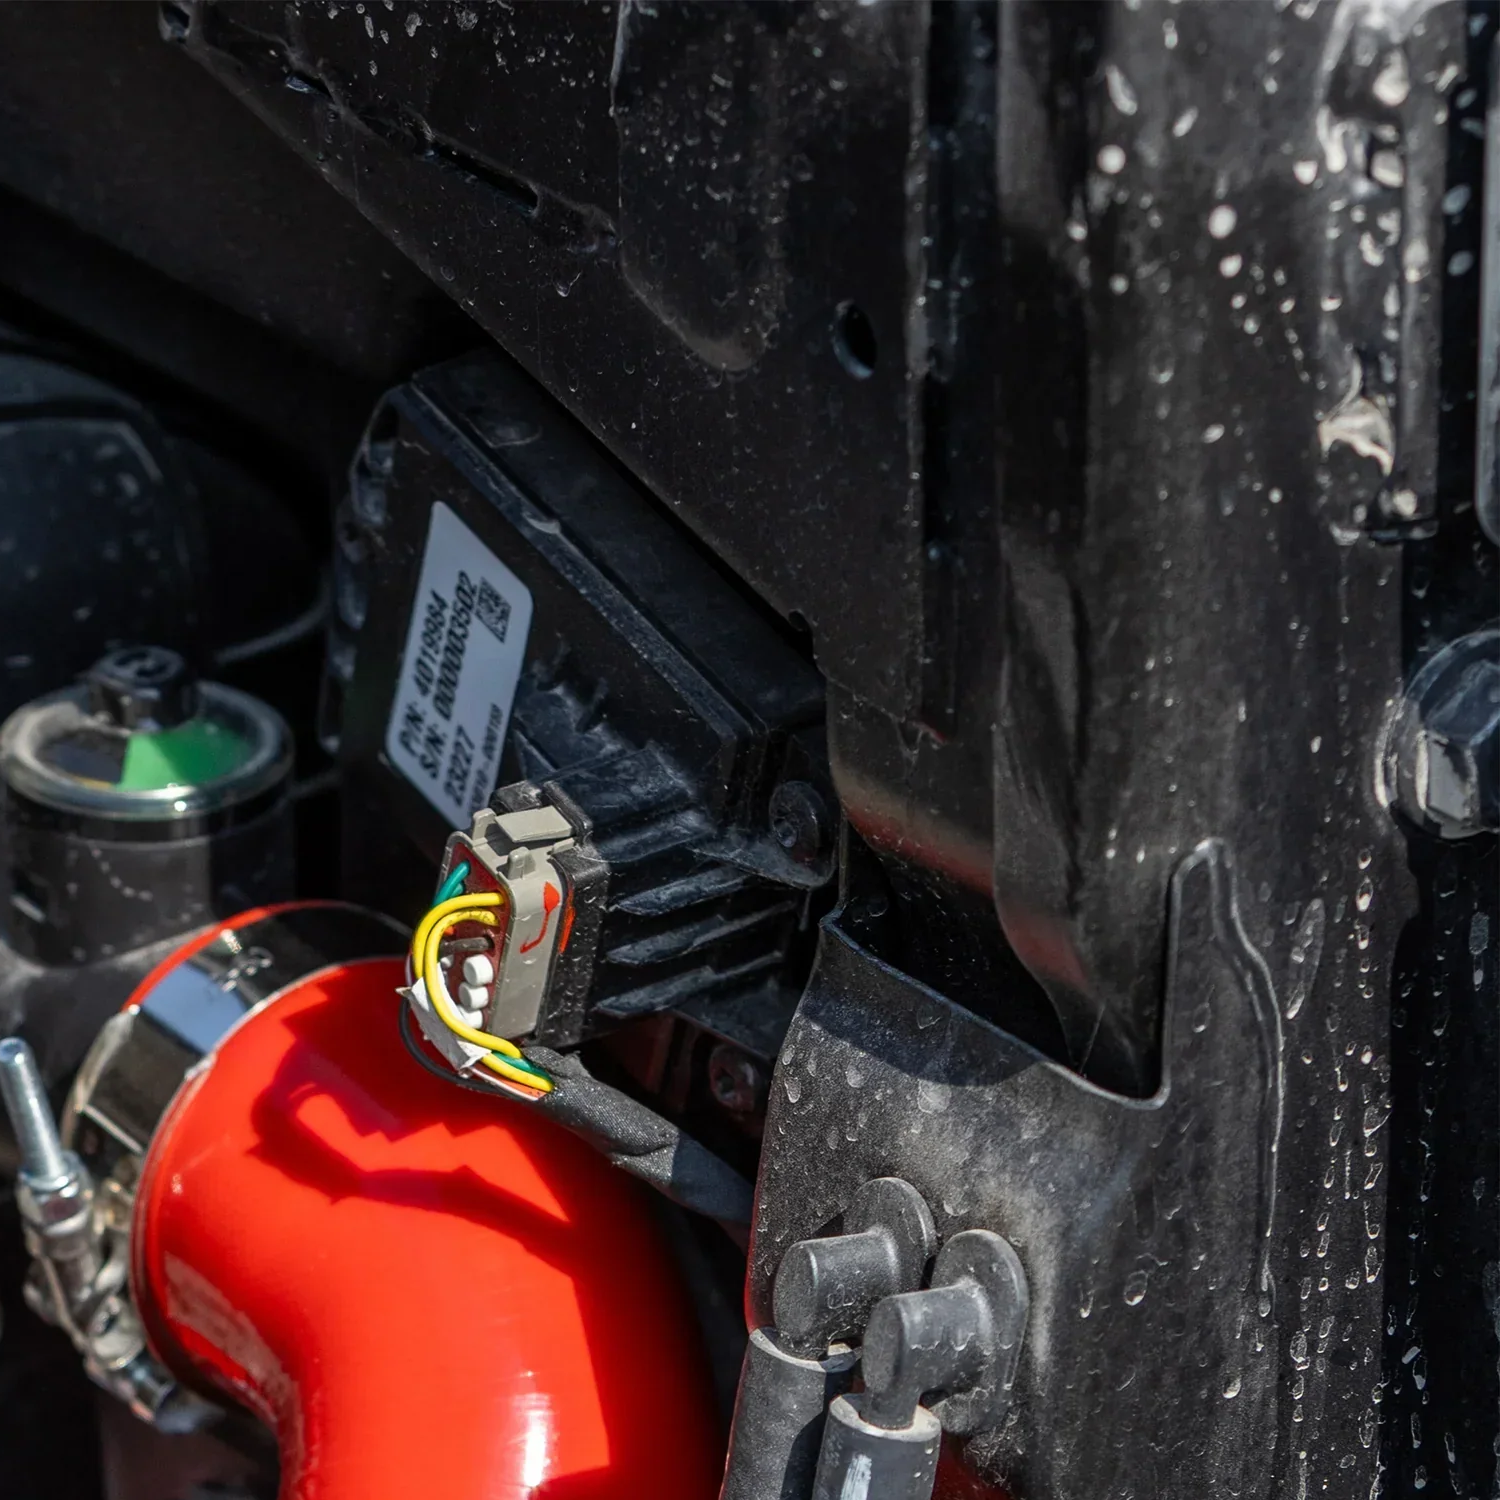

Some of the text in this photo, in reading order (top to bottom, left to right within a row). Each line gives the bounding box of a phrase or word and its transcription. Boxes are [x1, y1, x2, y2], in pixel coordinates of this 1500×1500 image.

[398, 588, 449, 758] P/N: 4019984
[418, 569, 478, 781] S/N: 000003502
[444, 725, 475, 807] 23227
